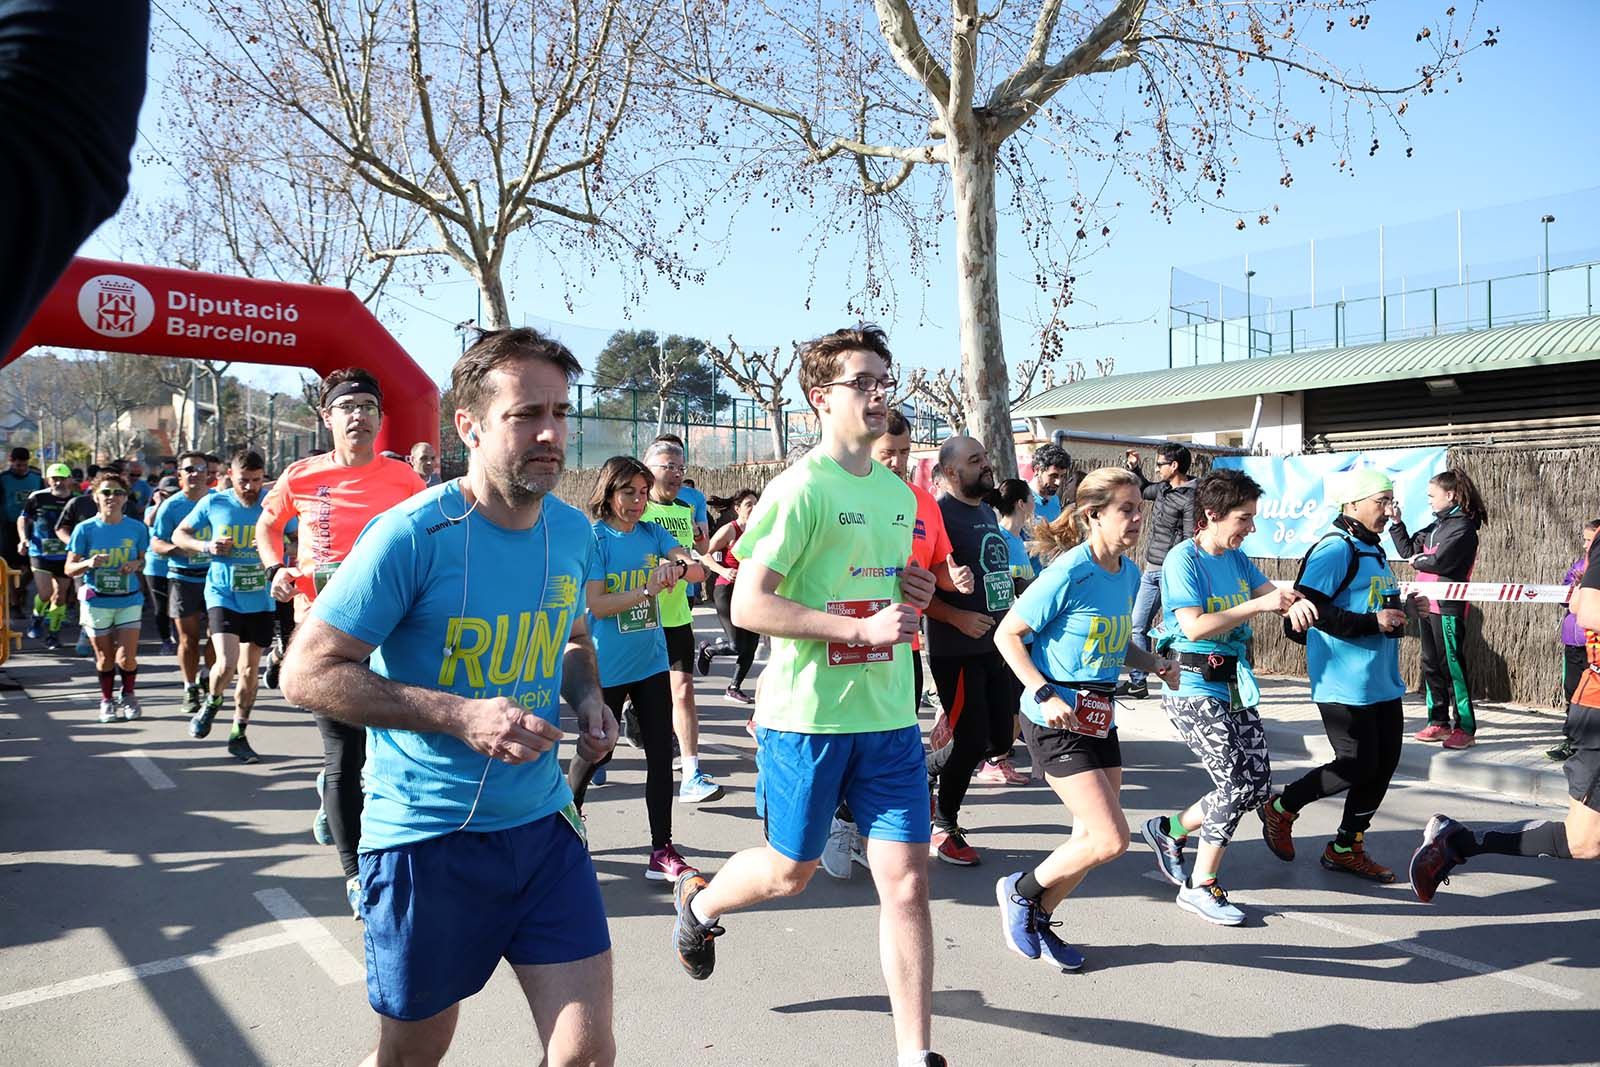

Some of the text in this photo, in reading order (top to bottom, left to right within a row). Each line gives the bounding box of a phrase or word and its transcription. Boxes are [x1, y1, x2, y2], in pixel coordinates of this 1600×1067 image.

[168, 290, 298, 322] Diputació
[167, 316, 297, 346] Barcelona
[1256, 497, 1318, 520] ulce
[1273, 521, 1296, 544] de
[241, 577, 258, 585] 315
[997, 590, 1010, 601] 127
[630, 609, 648, 621] 107
[438, 610, 568, 688] RUN
[1086, 711, 1106, 725] 412
